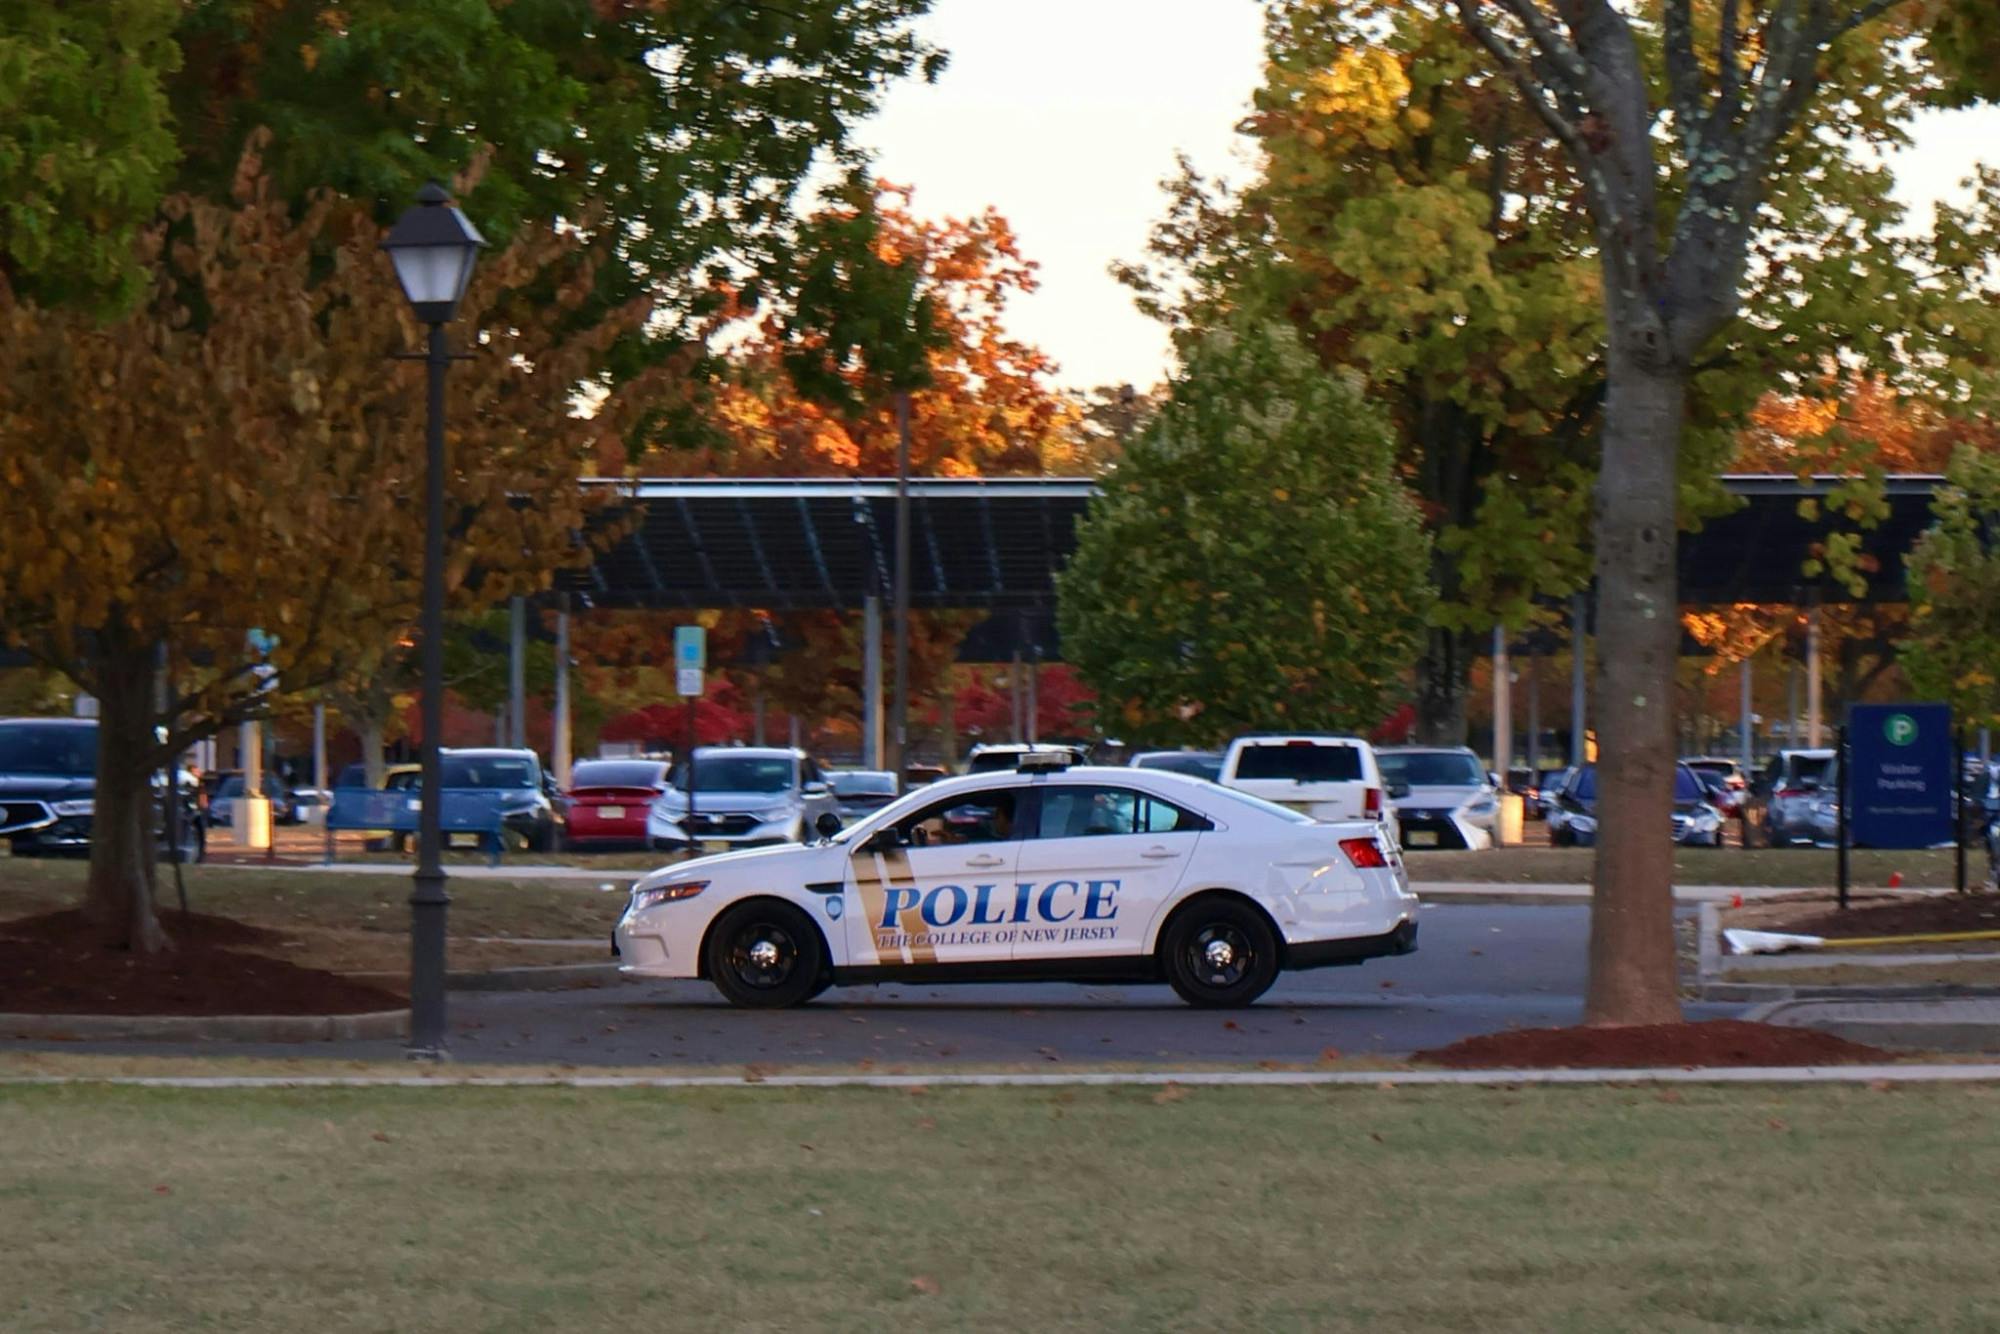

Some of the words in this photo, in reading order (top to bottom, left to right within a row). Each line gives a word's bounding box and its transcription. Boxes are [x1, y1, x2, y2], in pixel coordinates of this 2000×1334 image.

[1893, 720, 1912, 741] P
[878, 880, 1121, 928] POLICE
[880, 933, 911, 947] THE
[915, 931, 991, 945] COLLEGE
[995, 929, 1018, 943] OF
[1022, 928, 1060, 943] NEW
[1062, 926, 1119, 943] JERSEY
